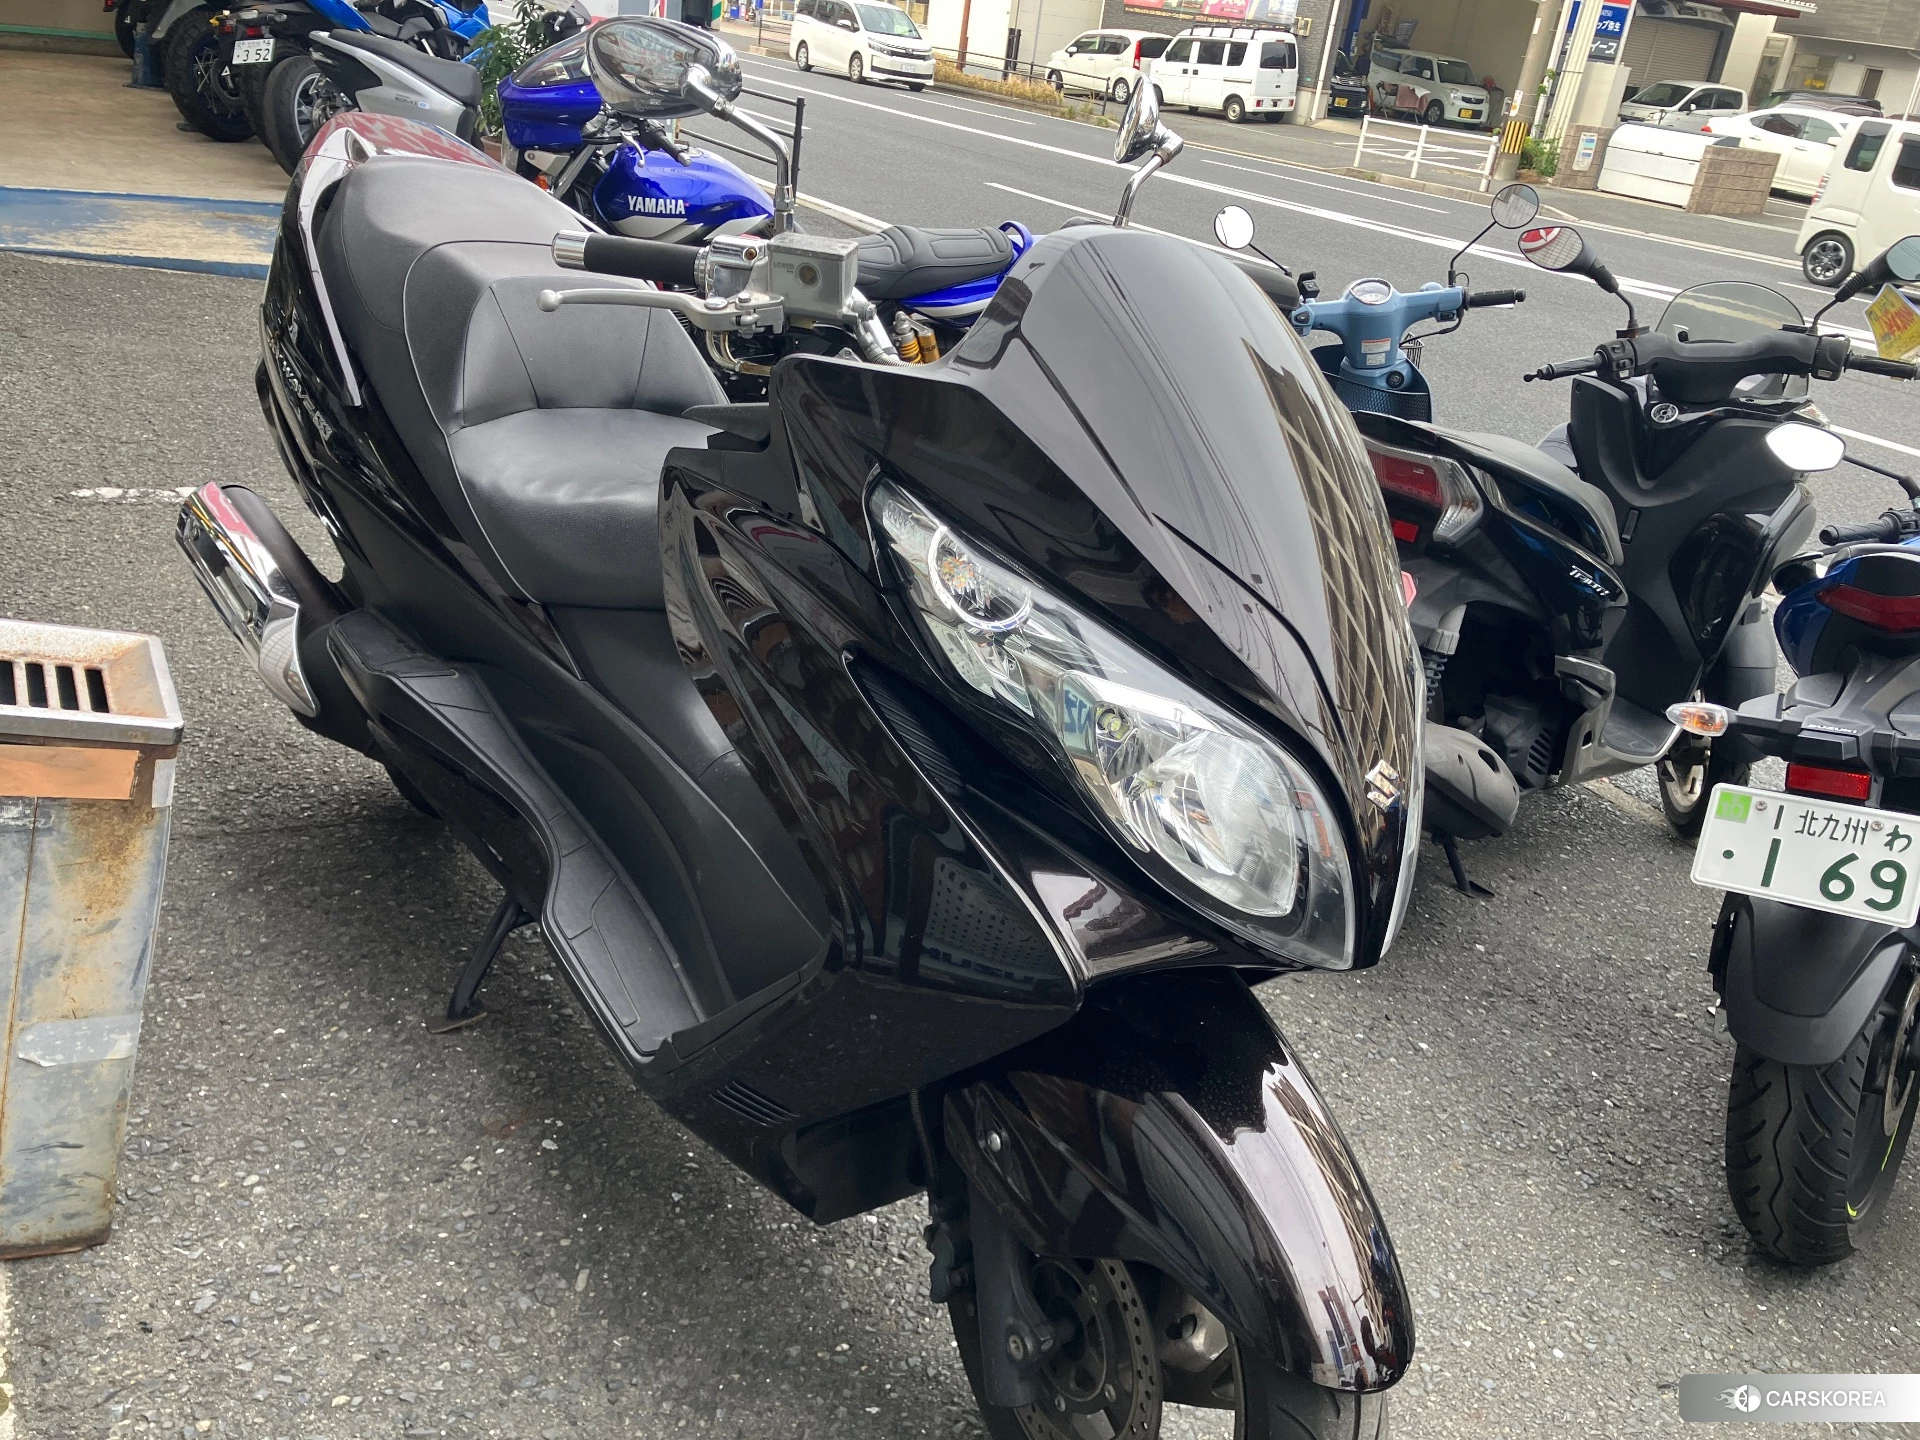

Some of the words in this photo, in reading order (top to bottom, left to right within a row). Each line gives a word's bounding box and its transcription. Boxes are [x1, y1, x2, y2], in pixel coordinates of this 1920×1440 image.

[627, 194, 686, 215] YAMAHA
[1795, 810, 1869, 846] 北九州
